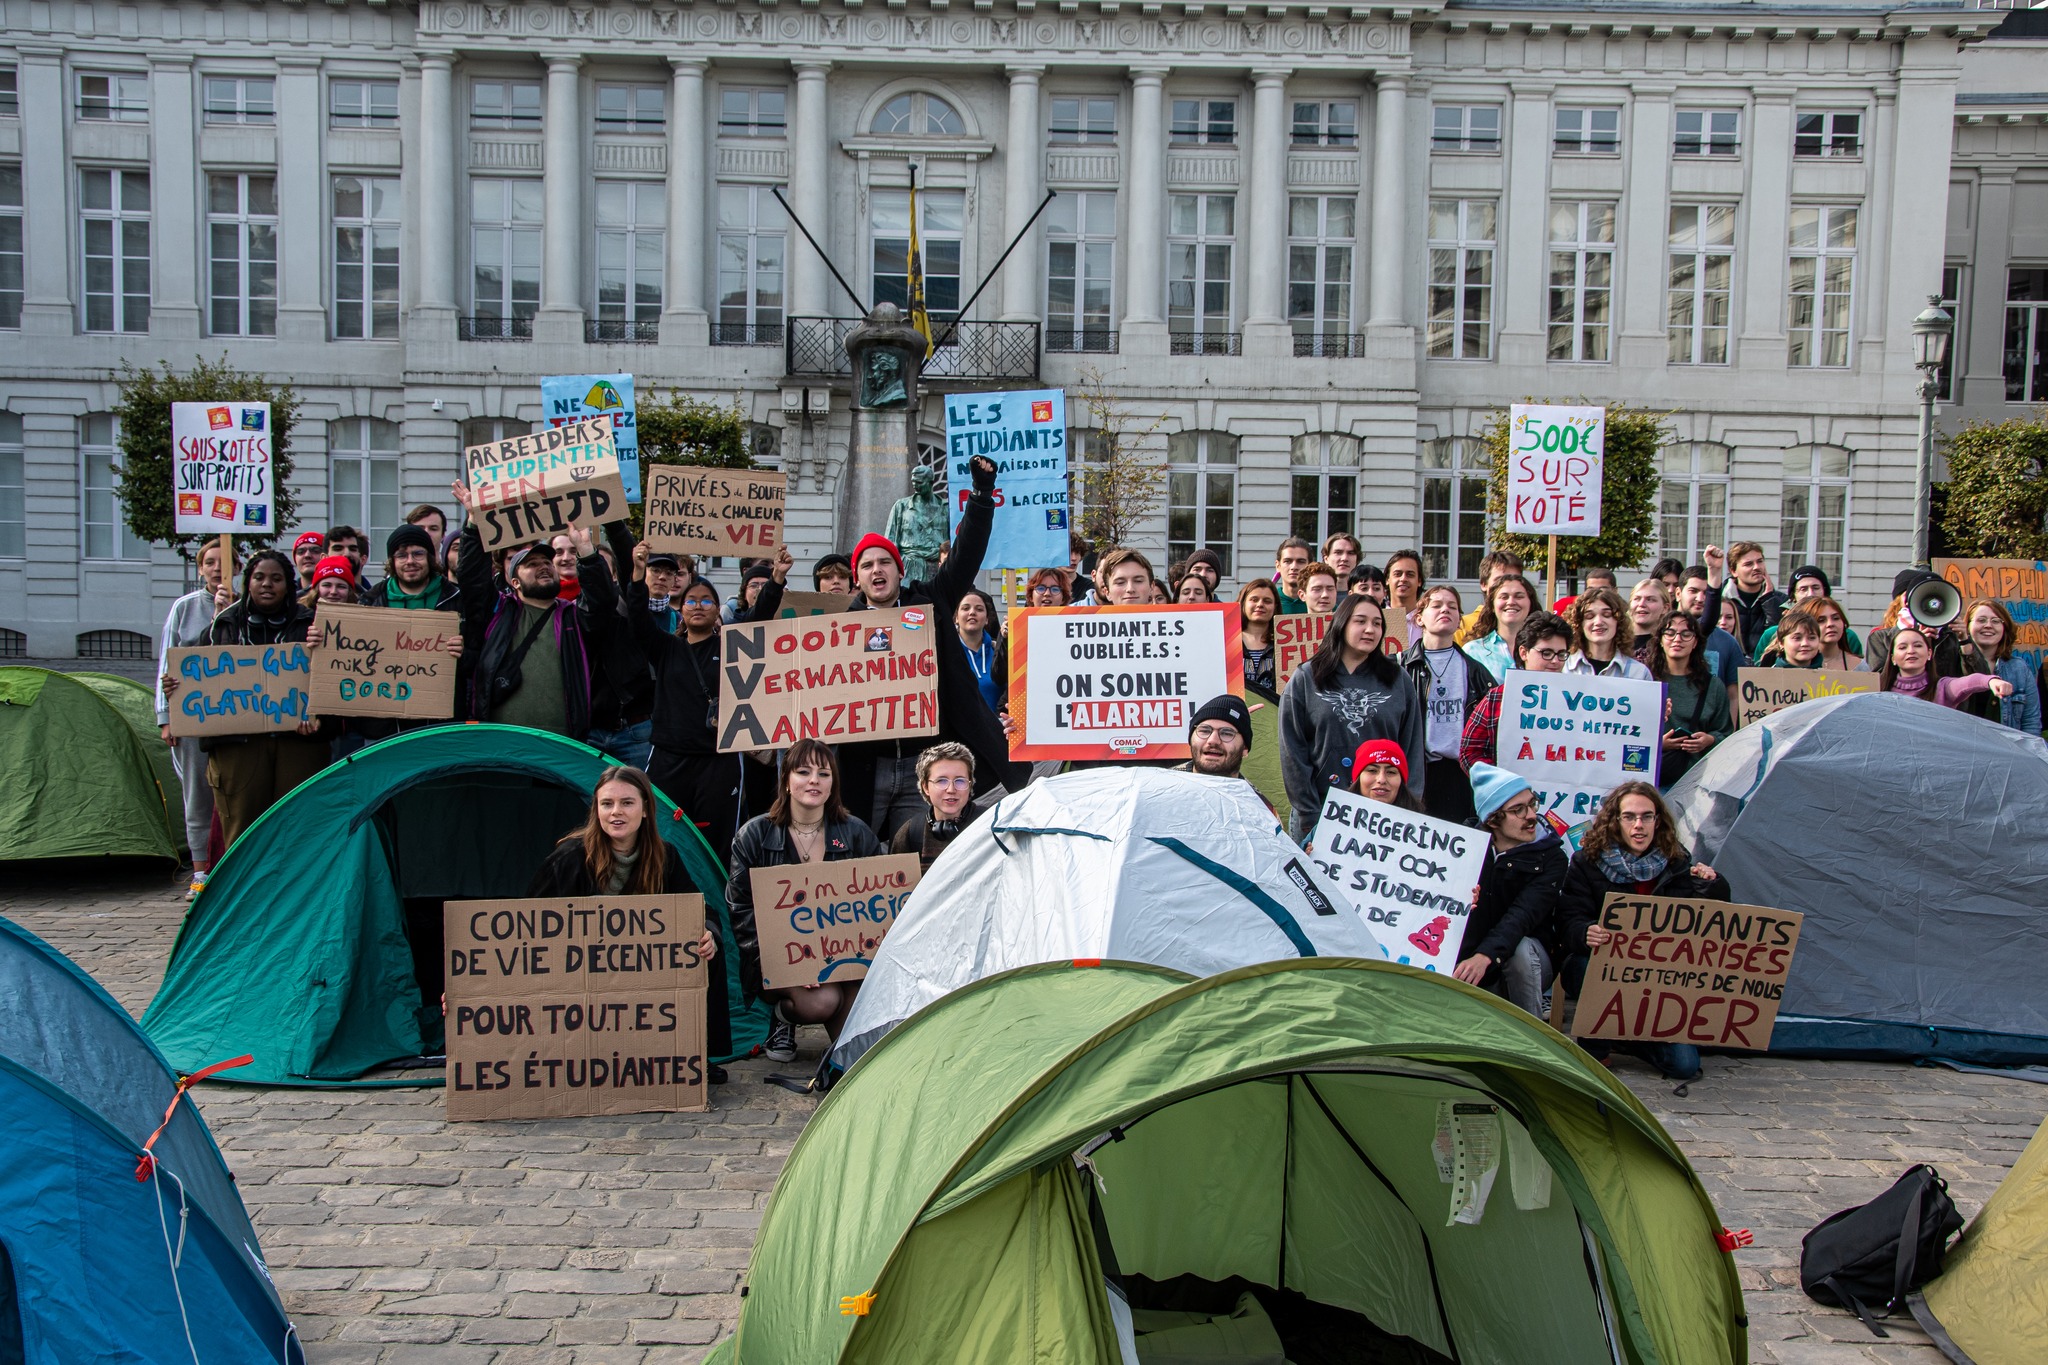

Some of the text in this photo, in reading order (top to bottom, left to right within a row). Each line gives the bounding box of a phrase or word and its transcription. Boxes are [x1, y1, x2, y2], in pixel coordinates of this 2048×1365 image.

[553, 397, 581, 415] NE
[948, 403, 1003, 428] LES
[1518, 419, 1598, 456] 500€
[472, 439, 616, 485] STUDENTEN
[1517, 455, 1590, 487] SUR
[477, 472, 548, 512] ÉEN
[733, 487, 743, 498] de
[748, 482, 786, 501] BOUFFE
[958, 488, 1067, 512] PS LA CRISE
[485, 488, 611, 546] STRIJD
[708, 507, 719, 519] de
[721, 504, 783, 522] CHALEUR
[1514, 490, 1587, 525] KOTÉ
[705, 530, 718, 542] de
[725, 523, 776, 547] VIE
[1065, 619, 1185, 639] ETUDIANT.E.S
[1276, 615, 1332, 644] SHI
[1070, 639, 1170, 660] OUBLIÉ.E.S
[384, 663, 403, 680] op
[406, 663, 438, 677] ons
[339, 677, 413, 701] BORD
[1056, 672, 1188, 698] ON SONNE
[1742, 680, 1769, 704] On
[1055, 700, 1183, 728] L'ALARME
[1562, 690, 1632, 716] VOUS
[718, 689, 937, 750] AANZETTEN
[1519, 712, 1641, 738] NOUS METTEZ
[1545, 743, 1567, 762] LA
[1574, 746, 1607, 762] RUE
[1324, 800, 1352, 827] DE
[1330, 833, 1448, 883] LAAT OOK
[1290, 870, 1307, 888] FRESH
[1306, 889, 1323, 907] BLACK
[1350, 869, 1472, 917] STUDENTEN
[1367, 906, 1402, 928] DE
[451, 948, 488, 977] DE
[565, 938, 701, 975] DÉCENTES
[1621, 966, 1654, 984] EST
[1656, 968, 1709, 989] TEMPS
[1712, 973, 1740, 993] DE
[1740, 977, 1785, 1000] NOUS
[456, 1004, 535, 1037] POUR
[454, 1059, 511, 1092] LES
